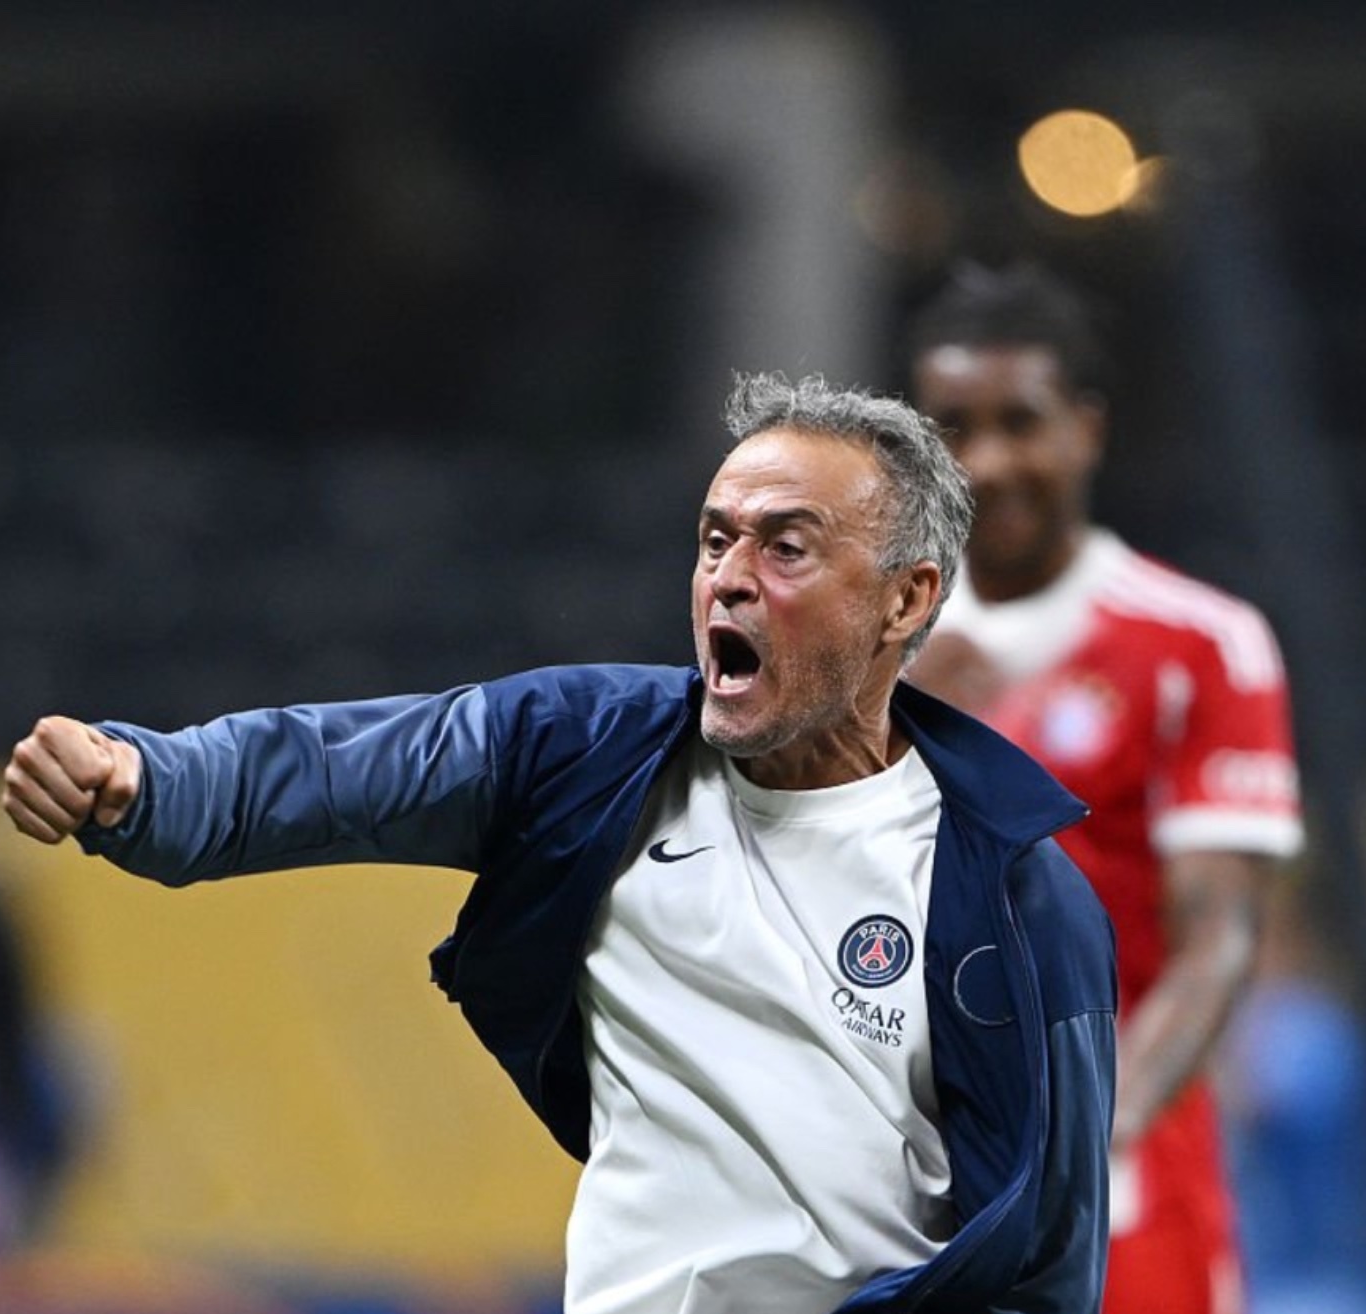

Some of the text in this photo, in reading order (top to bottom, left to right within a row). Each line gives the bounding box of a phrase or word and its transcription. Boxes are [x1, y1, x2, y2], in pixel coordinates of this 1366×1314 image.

[858, 923, 900, 942] PARIS
[832, 987, 905, 1032] QATAR
[842, 1017, 902, 1047] AIRWAYS
